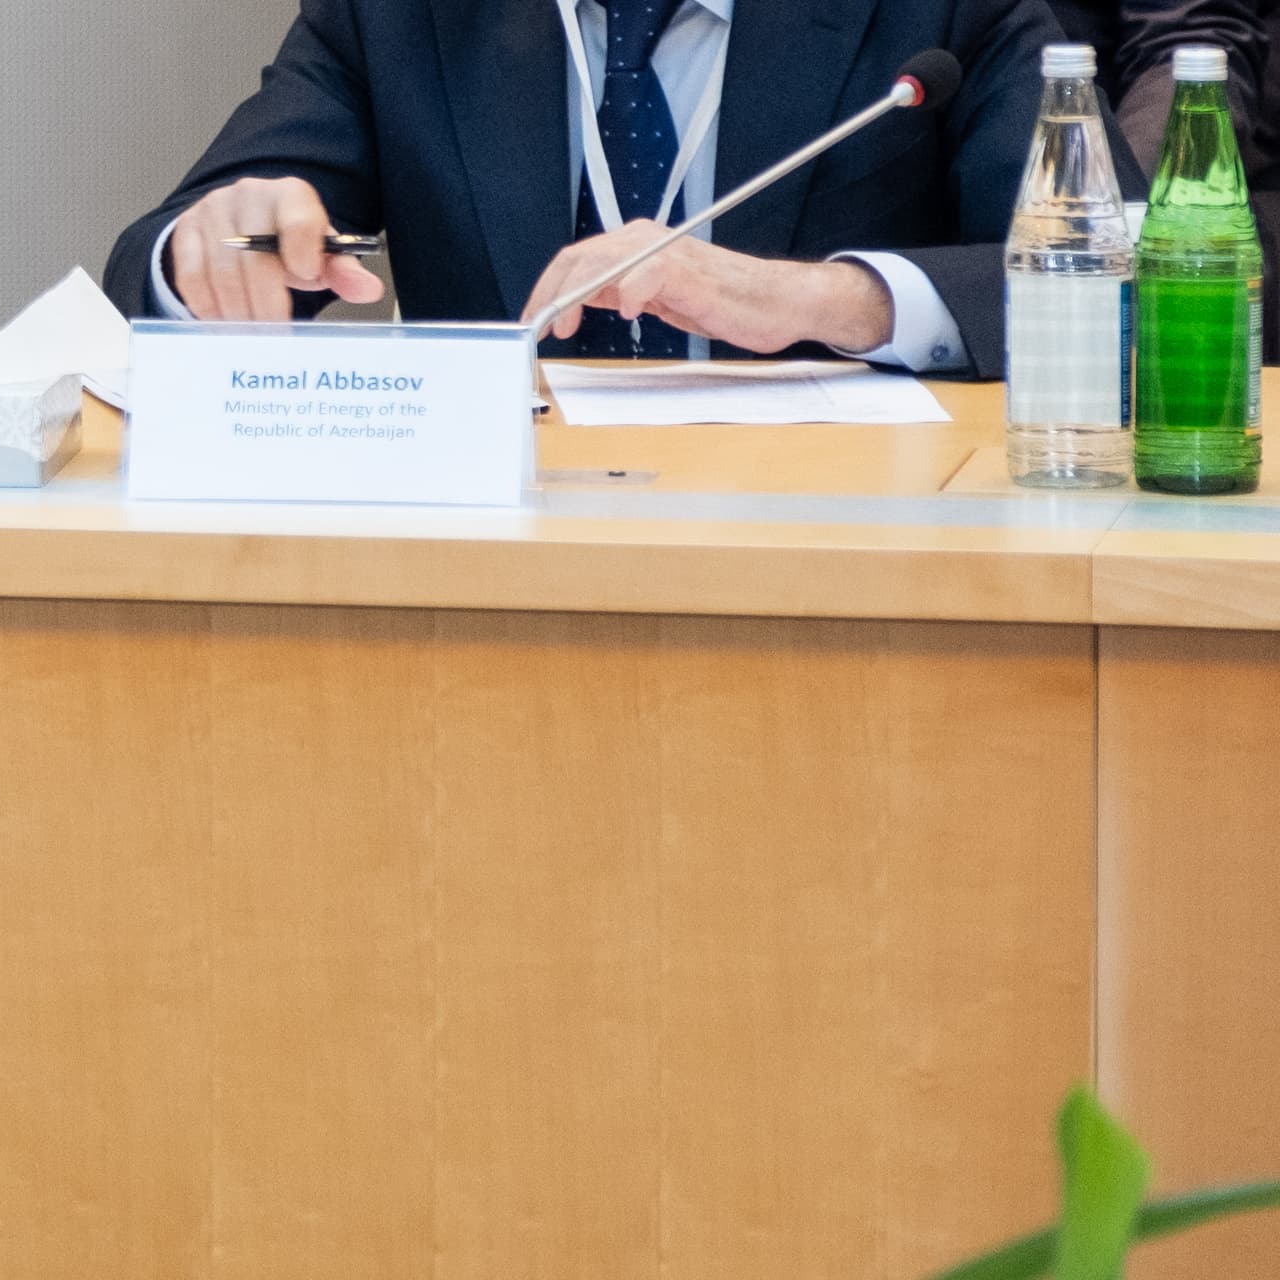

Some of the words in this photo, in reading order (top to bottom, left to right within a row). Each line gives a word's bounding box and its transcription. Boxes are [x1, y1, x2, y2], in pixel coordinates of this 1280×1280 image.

[231, 370, 307, 390] Kamal
[315, 370, 424, 392] Abbasov
[225, 401, 292, 417] Ministry
[296, 401, 313, 415] of
[318, 402, 374, 418] Energy
[378, 402, 396, 416] of
[399, 402, 427, 417] the
[233, 423, 303, 439] Republic
[308, 424, 325, 438] of
[328, 424, 415, 441] Azerbaijan
